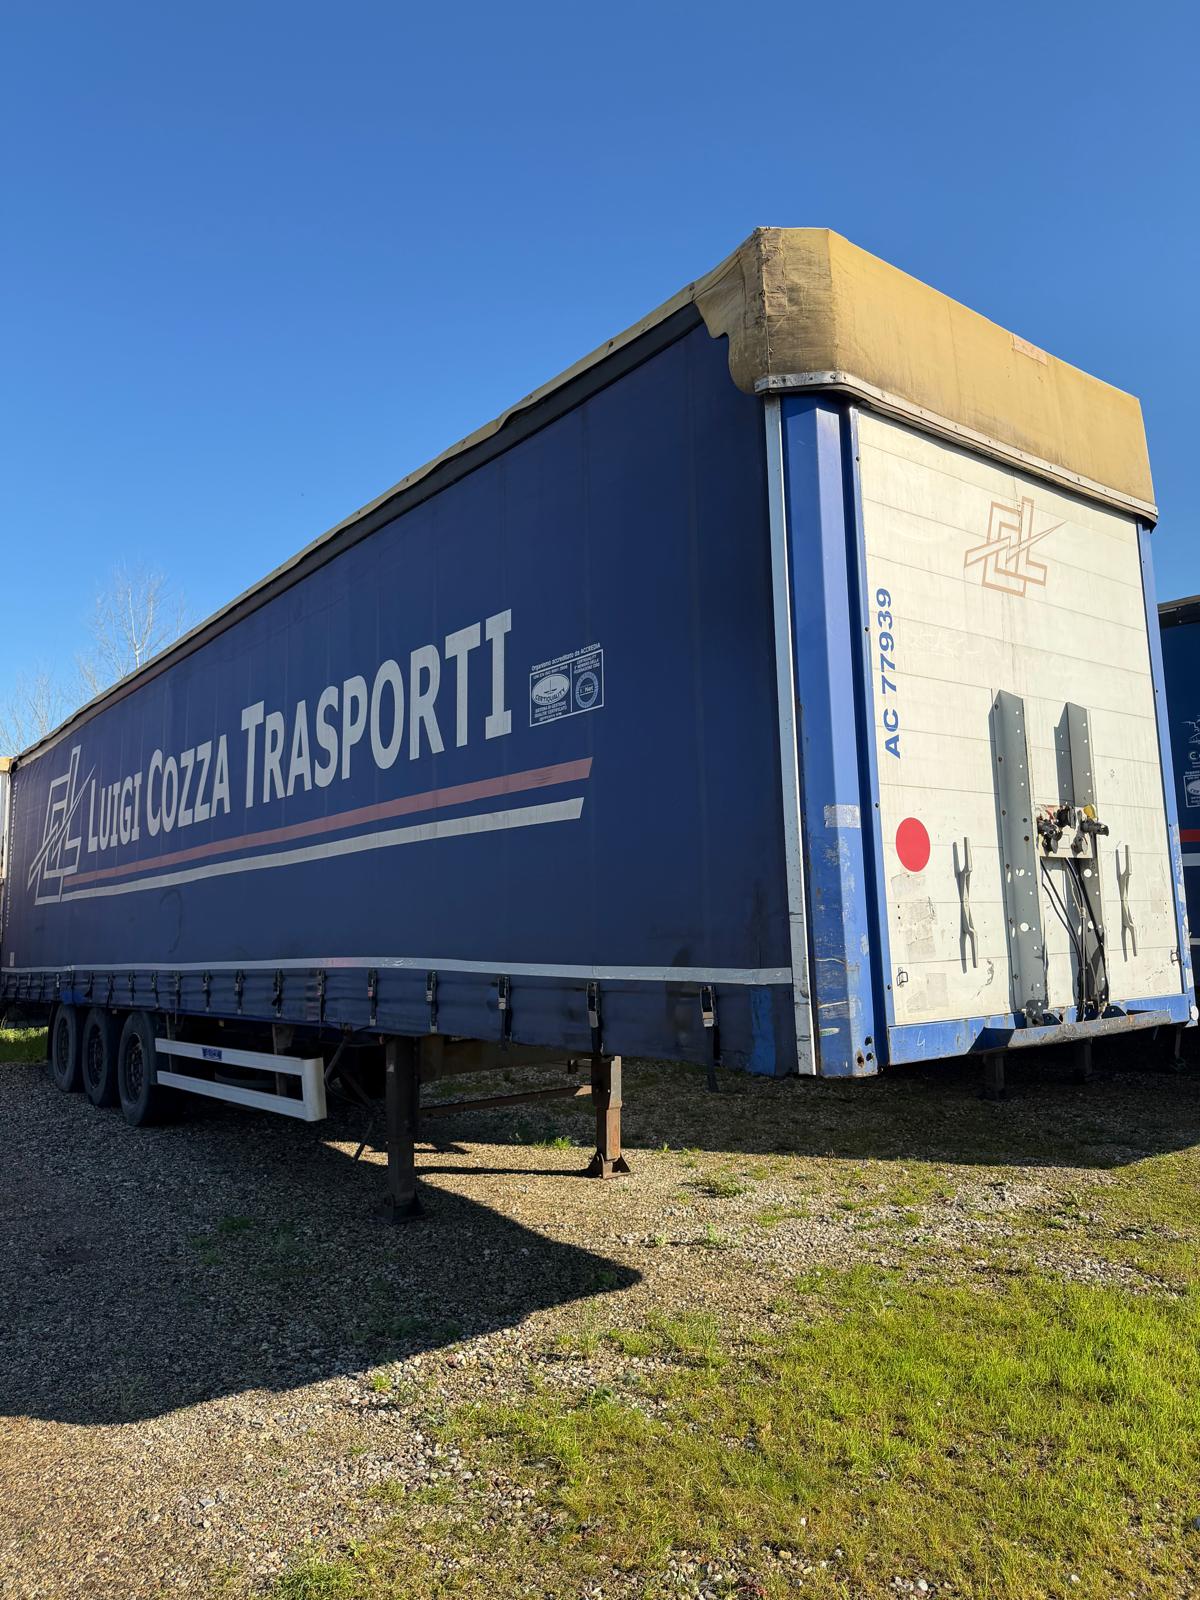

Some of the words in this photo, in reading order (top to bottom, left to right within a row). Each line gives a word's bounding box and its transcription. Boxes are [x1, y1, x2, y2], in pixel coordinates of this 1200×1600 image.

[876, 588, 897, 695] 77939
[88, 771, 142, 853] LUIGI
[147, 733, 231, 837] COZZA
[241, 609, 512, 809] TRASPORTI
[883, 708, 901, 759] AC
